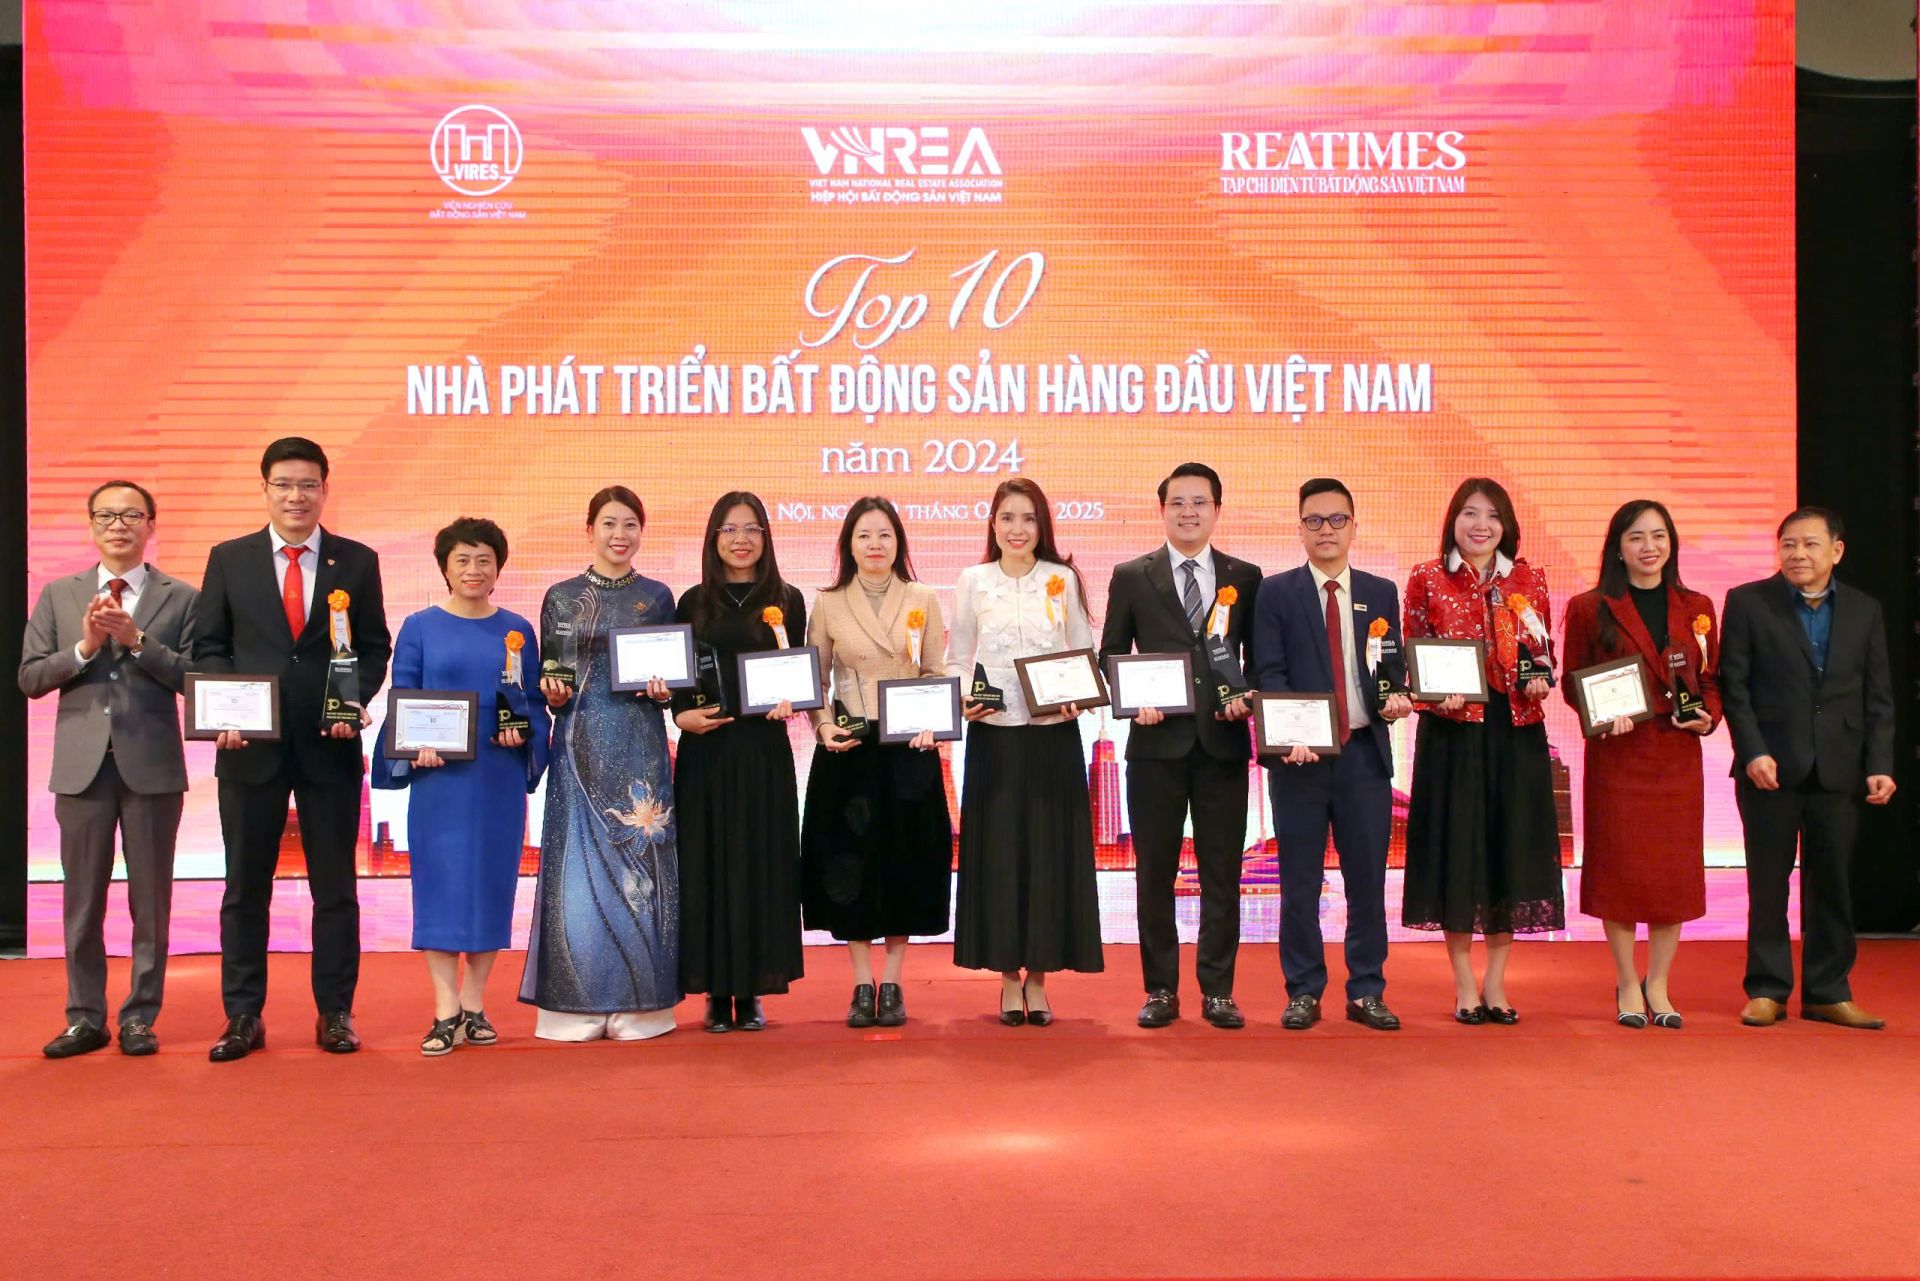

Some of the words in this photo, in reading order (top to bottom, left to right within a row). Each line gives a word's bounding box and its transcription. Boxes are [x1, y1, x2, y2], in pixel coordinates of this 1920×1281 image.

[1220, 131, 1466, 171] REATIMES
[453, 163, 500, 181] VIRES
[809, 179, 828, 188] VIET
[830, 179, 849, 188] NAM
[851, 179, 892, 188] NATIONAL
[895, 179, 915, 188] REAL
[918, 179, 946, 188] ESTATE
[949, 179, 1004, 188] ASSOCIATION
[1437, 176, 1465, 193] NAM
[811, 191, 836, 204] HIỆP
[837, 191, 858, 204] HỘI
[861, 191, 881, 202] BẤT
[883, 191, 920, 204] ĐỘNG
[923, 190, 946, 202] SẢN
[948, 191, 972, 204] VIỆT
[974, 191, 1002, 202] NAM
[799, 246, 928, 350] Top
[949, 249, 1045, 331] 10
[407, 355, 490, 415] NHÀ
[501, 355, 604, 415] PHÁT
[614, 344, 730, 415] TRIỂN
[742, 349, 819, 414] BẤT
[829, 354, 937, 424] ĐỘNG
[947, 348, 1026, 413] SẢN
[1038, 354, 1144, 413] HÀNG
[1154, 349, 1235, 413] ĐẦU
[1245, 354, 1332, 423] VIỆT
[1343, 363, 1431, 413] NAM
[821, 441, 911, 474] năm
[923, 438, 1024, 473] 2024
[906, 501, 968, 520] THÁNG
[1056, 501, 1104, 520] 2025
